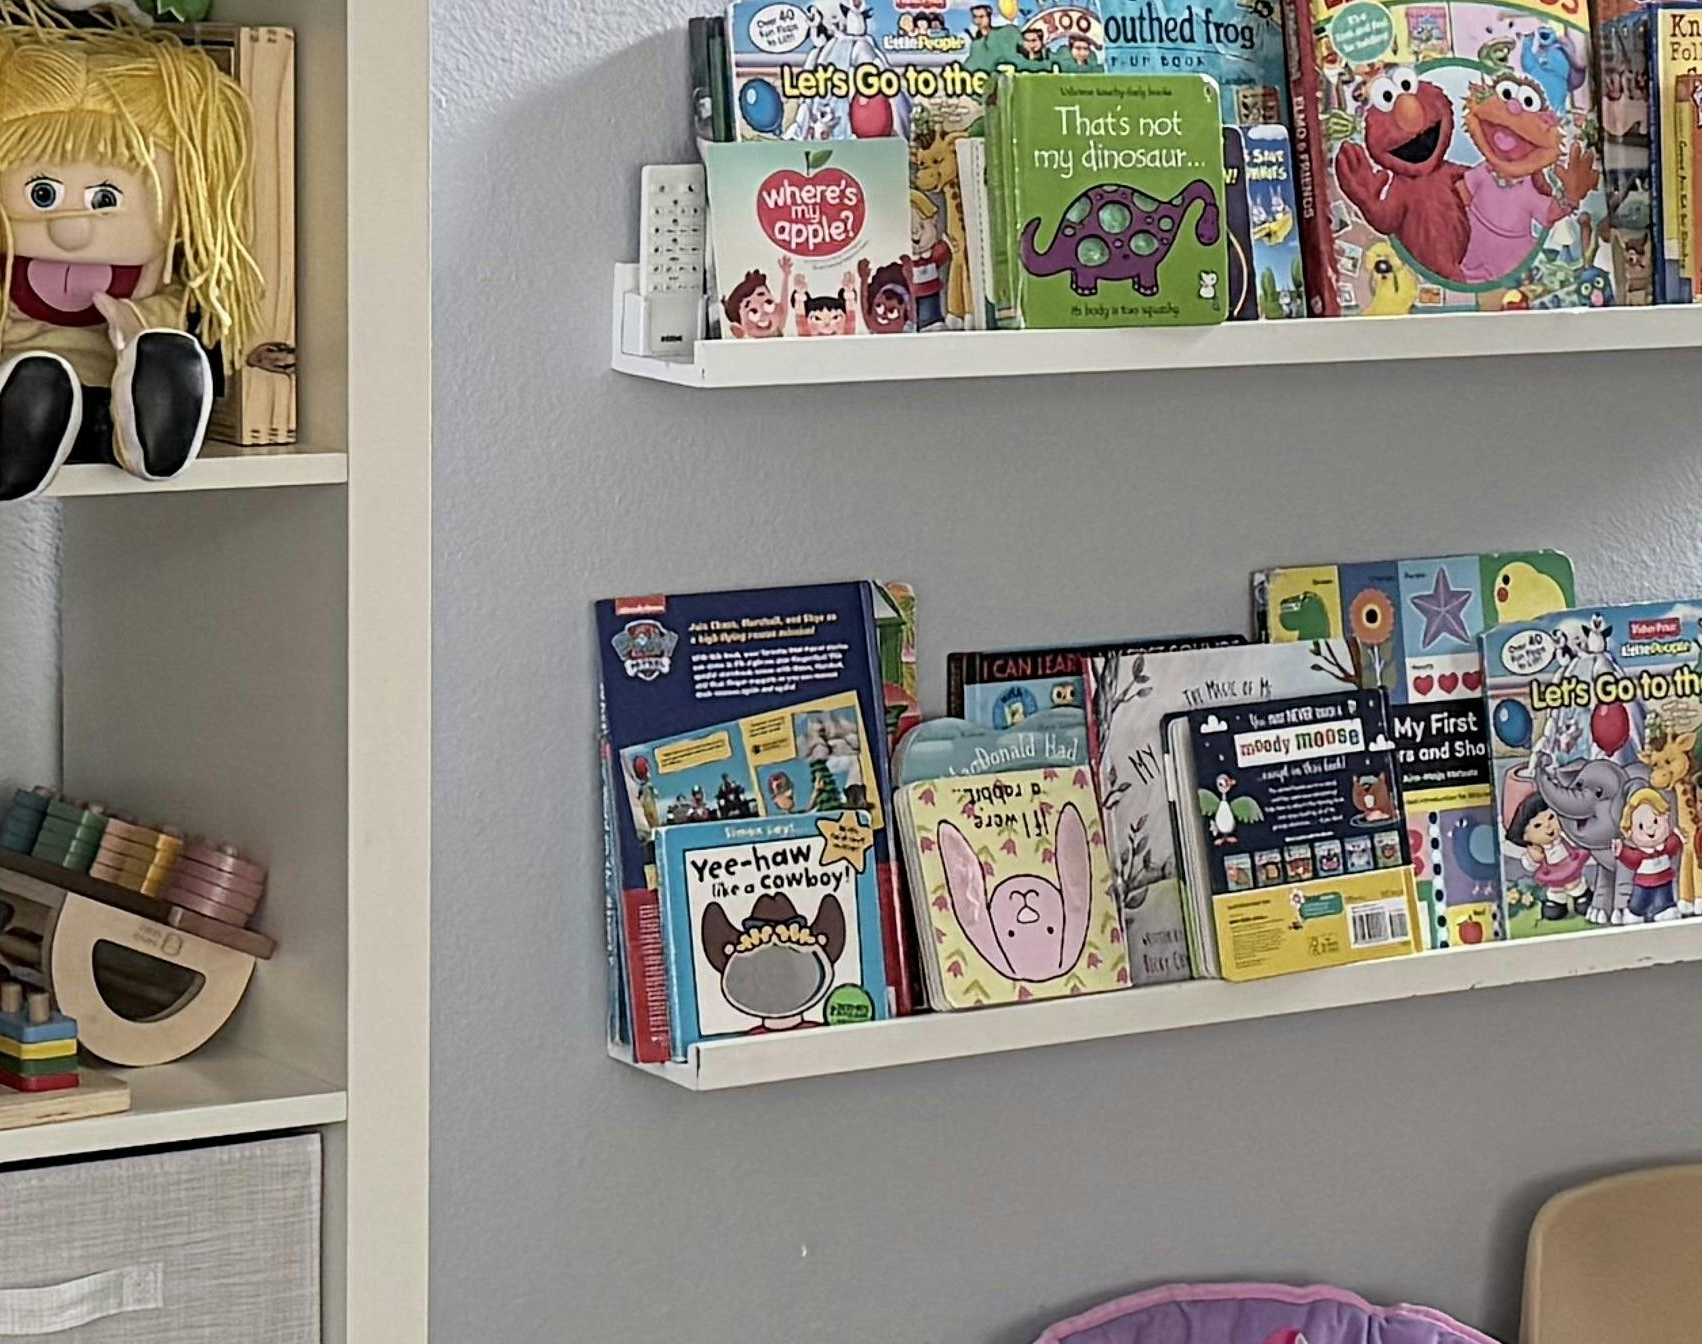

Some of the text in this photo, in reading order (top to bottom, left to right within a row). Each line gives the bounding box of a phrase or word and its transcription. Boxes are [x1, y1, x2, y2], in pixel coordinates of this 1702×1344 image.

[779, 10, 795, 22] 40
[1105, 2, 1255, 49] outhed frog
[784, 64, 847, 97] Let's
[856, 63, 898, 96] Go
[906, 65, 935, 96] to
[943, 61, 987, 94] the
[1055, 105, 1182, 137] That's not
[1294, 96, 1307, 140] ELMO
[1034, 140, 1206, 178] my dinosaur...
[762, 179, 857, 209] where's
[1299, 154, 1314, 218] FRIENDS
[791, 205, 820, 222] my
[774, 210, 854, 250] apple?
[1528, 634, 1543, 646] 40
[982, 653, 1086, 680] I CAN LEAR
[1206, 680, 1237, 700] MAGIC
[1242, 680, 1253, 696] OF
[1532, 680, 1589, 709] Let's
[1598, 673, 1634, 704] Go
[1643, 673, 1667, 699] to
[1240, 728, 1360, 756] moody moose
[1394, 711, 1478, 743] My First
[1045, 732, 1078, 761] Had
[1398, 750, 1415, 763] rs
[1419, 741, 1450, 761] and
[1128, 743, 1161, 784] MY
[974, 813, 1018, 830] were
[690, 844, 811, 883] Yee-haw
[712, 865, 850, 898] like a cowboy!
